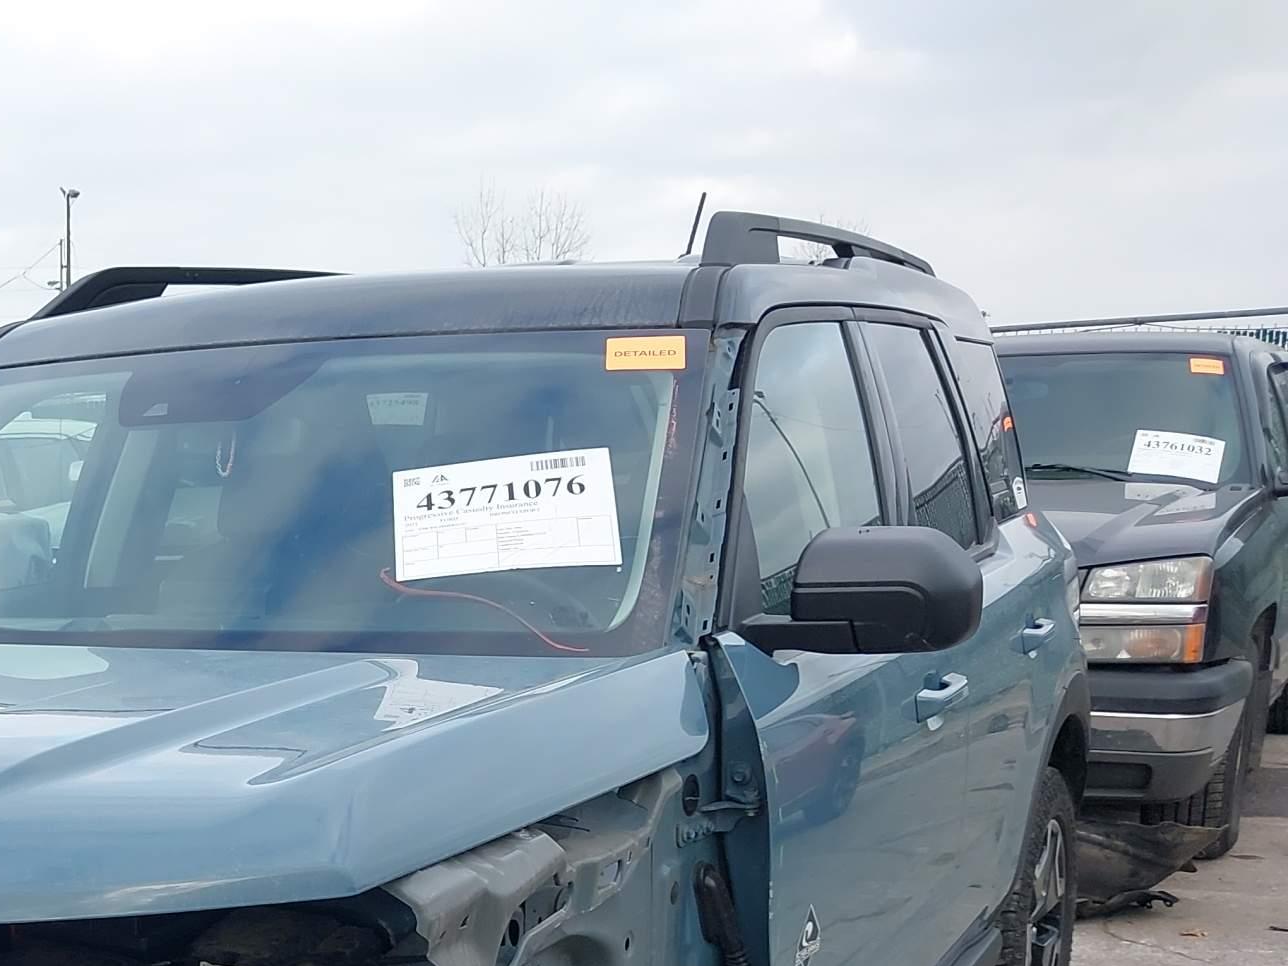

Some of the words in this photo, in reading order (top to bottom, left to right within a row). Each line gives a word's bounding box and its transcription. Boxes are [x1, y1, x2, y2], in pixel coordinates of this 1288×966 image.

[614, 349, 677, 357] DETAILED
[1143, 440, 1212, 455] 43761032
[416, 474, 586, 511] 43771076
